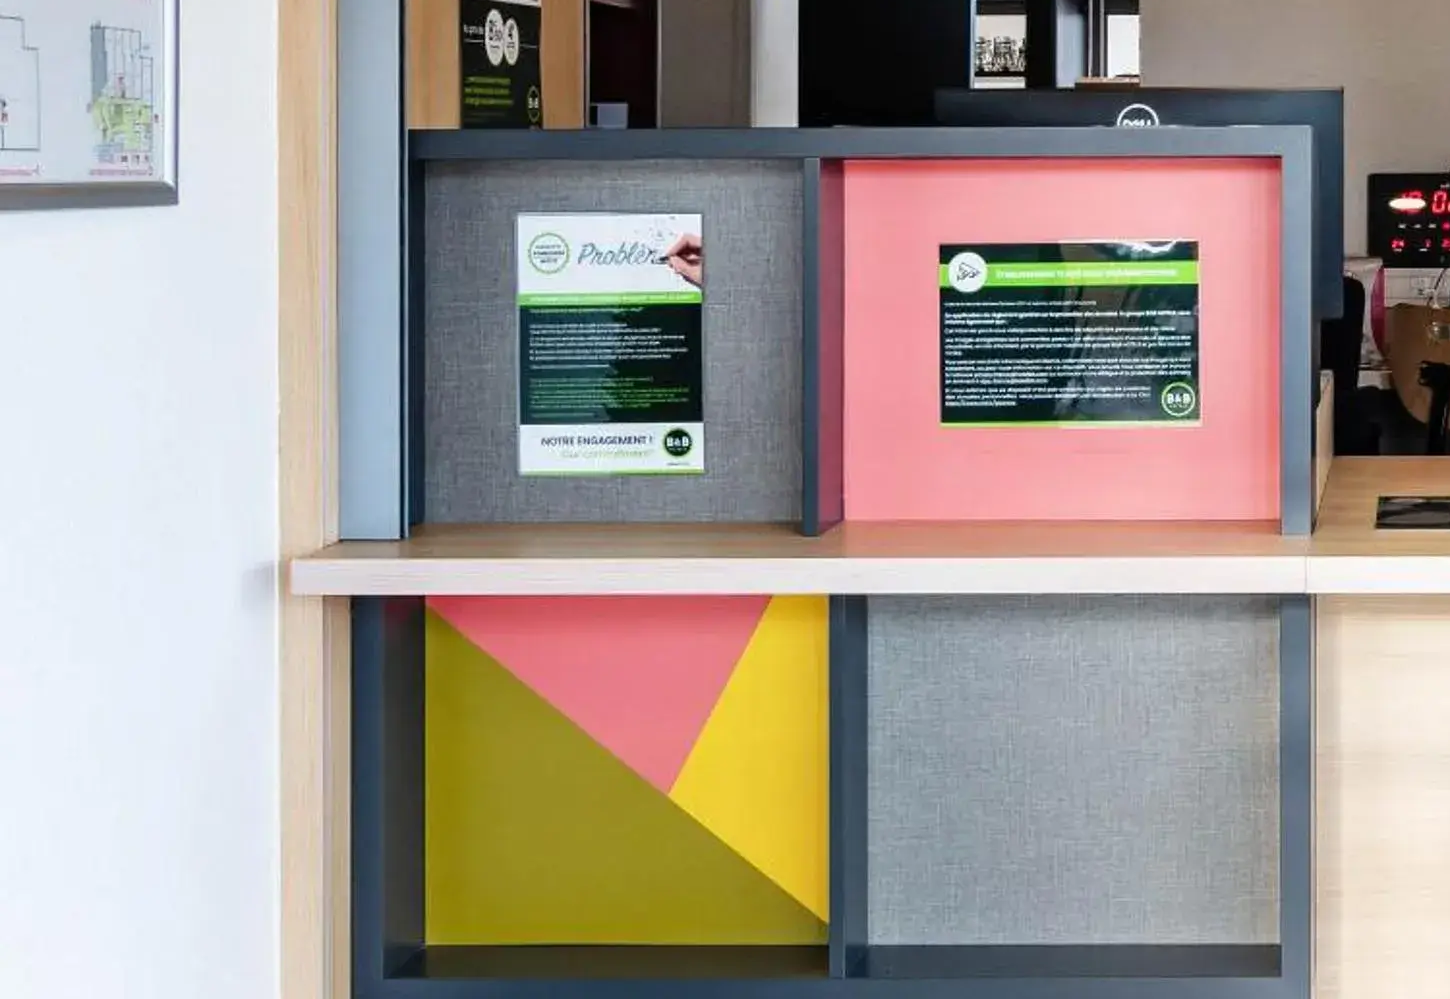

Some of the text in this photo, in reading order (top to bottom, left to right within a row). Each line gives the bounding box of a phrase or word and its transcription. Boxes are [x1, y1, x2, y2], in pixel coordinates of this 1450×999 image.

[1167, 392, 1191, 404] B&B
[578, 434, 647, 446] ENGAGEMENT
[666, 436, 690, 447] B&B
